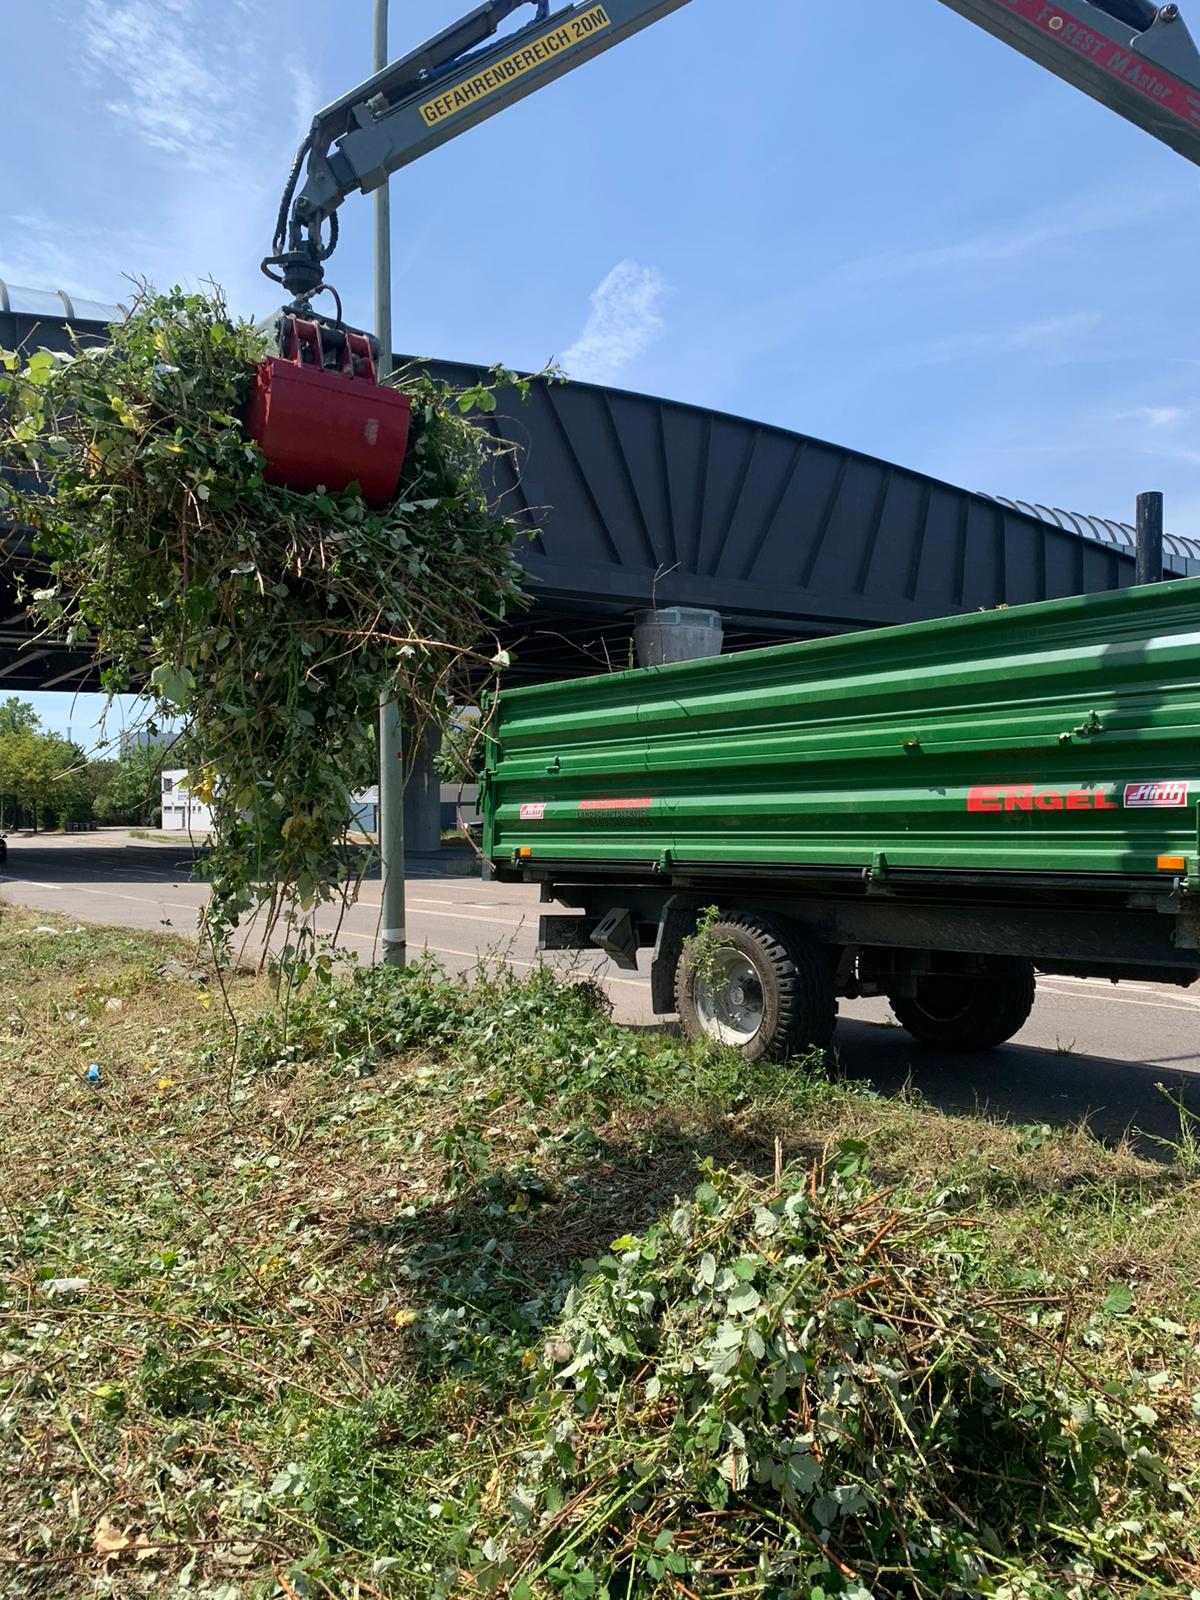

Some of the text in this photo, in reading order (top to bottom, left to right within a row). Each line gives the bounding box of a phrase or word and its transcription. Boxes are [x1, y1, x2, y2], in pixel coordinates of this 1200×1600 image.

[423, 9, 608, 122] GEFAHRENBEREICH 20M
[967, 784, 1118, 812] ENGEL
